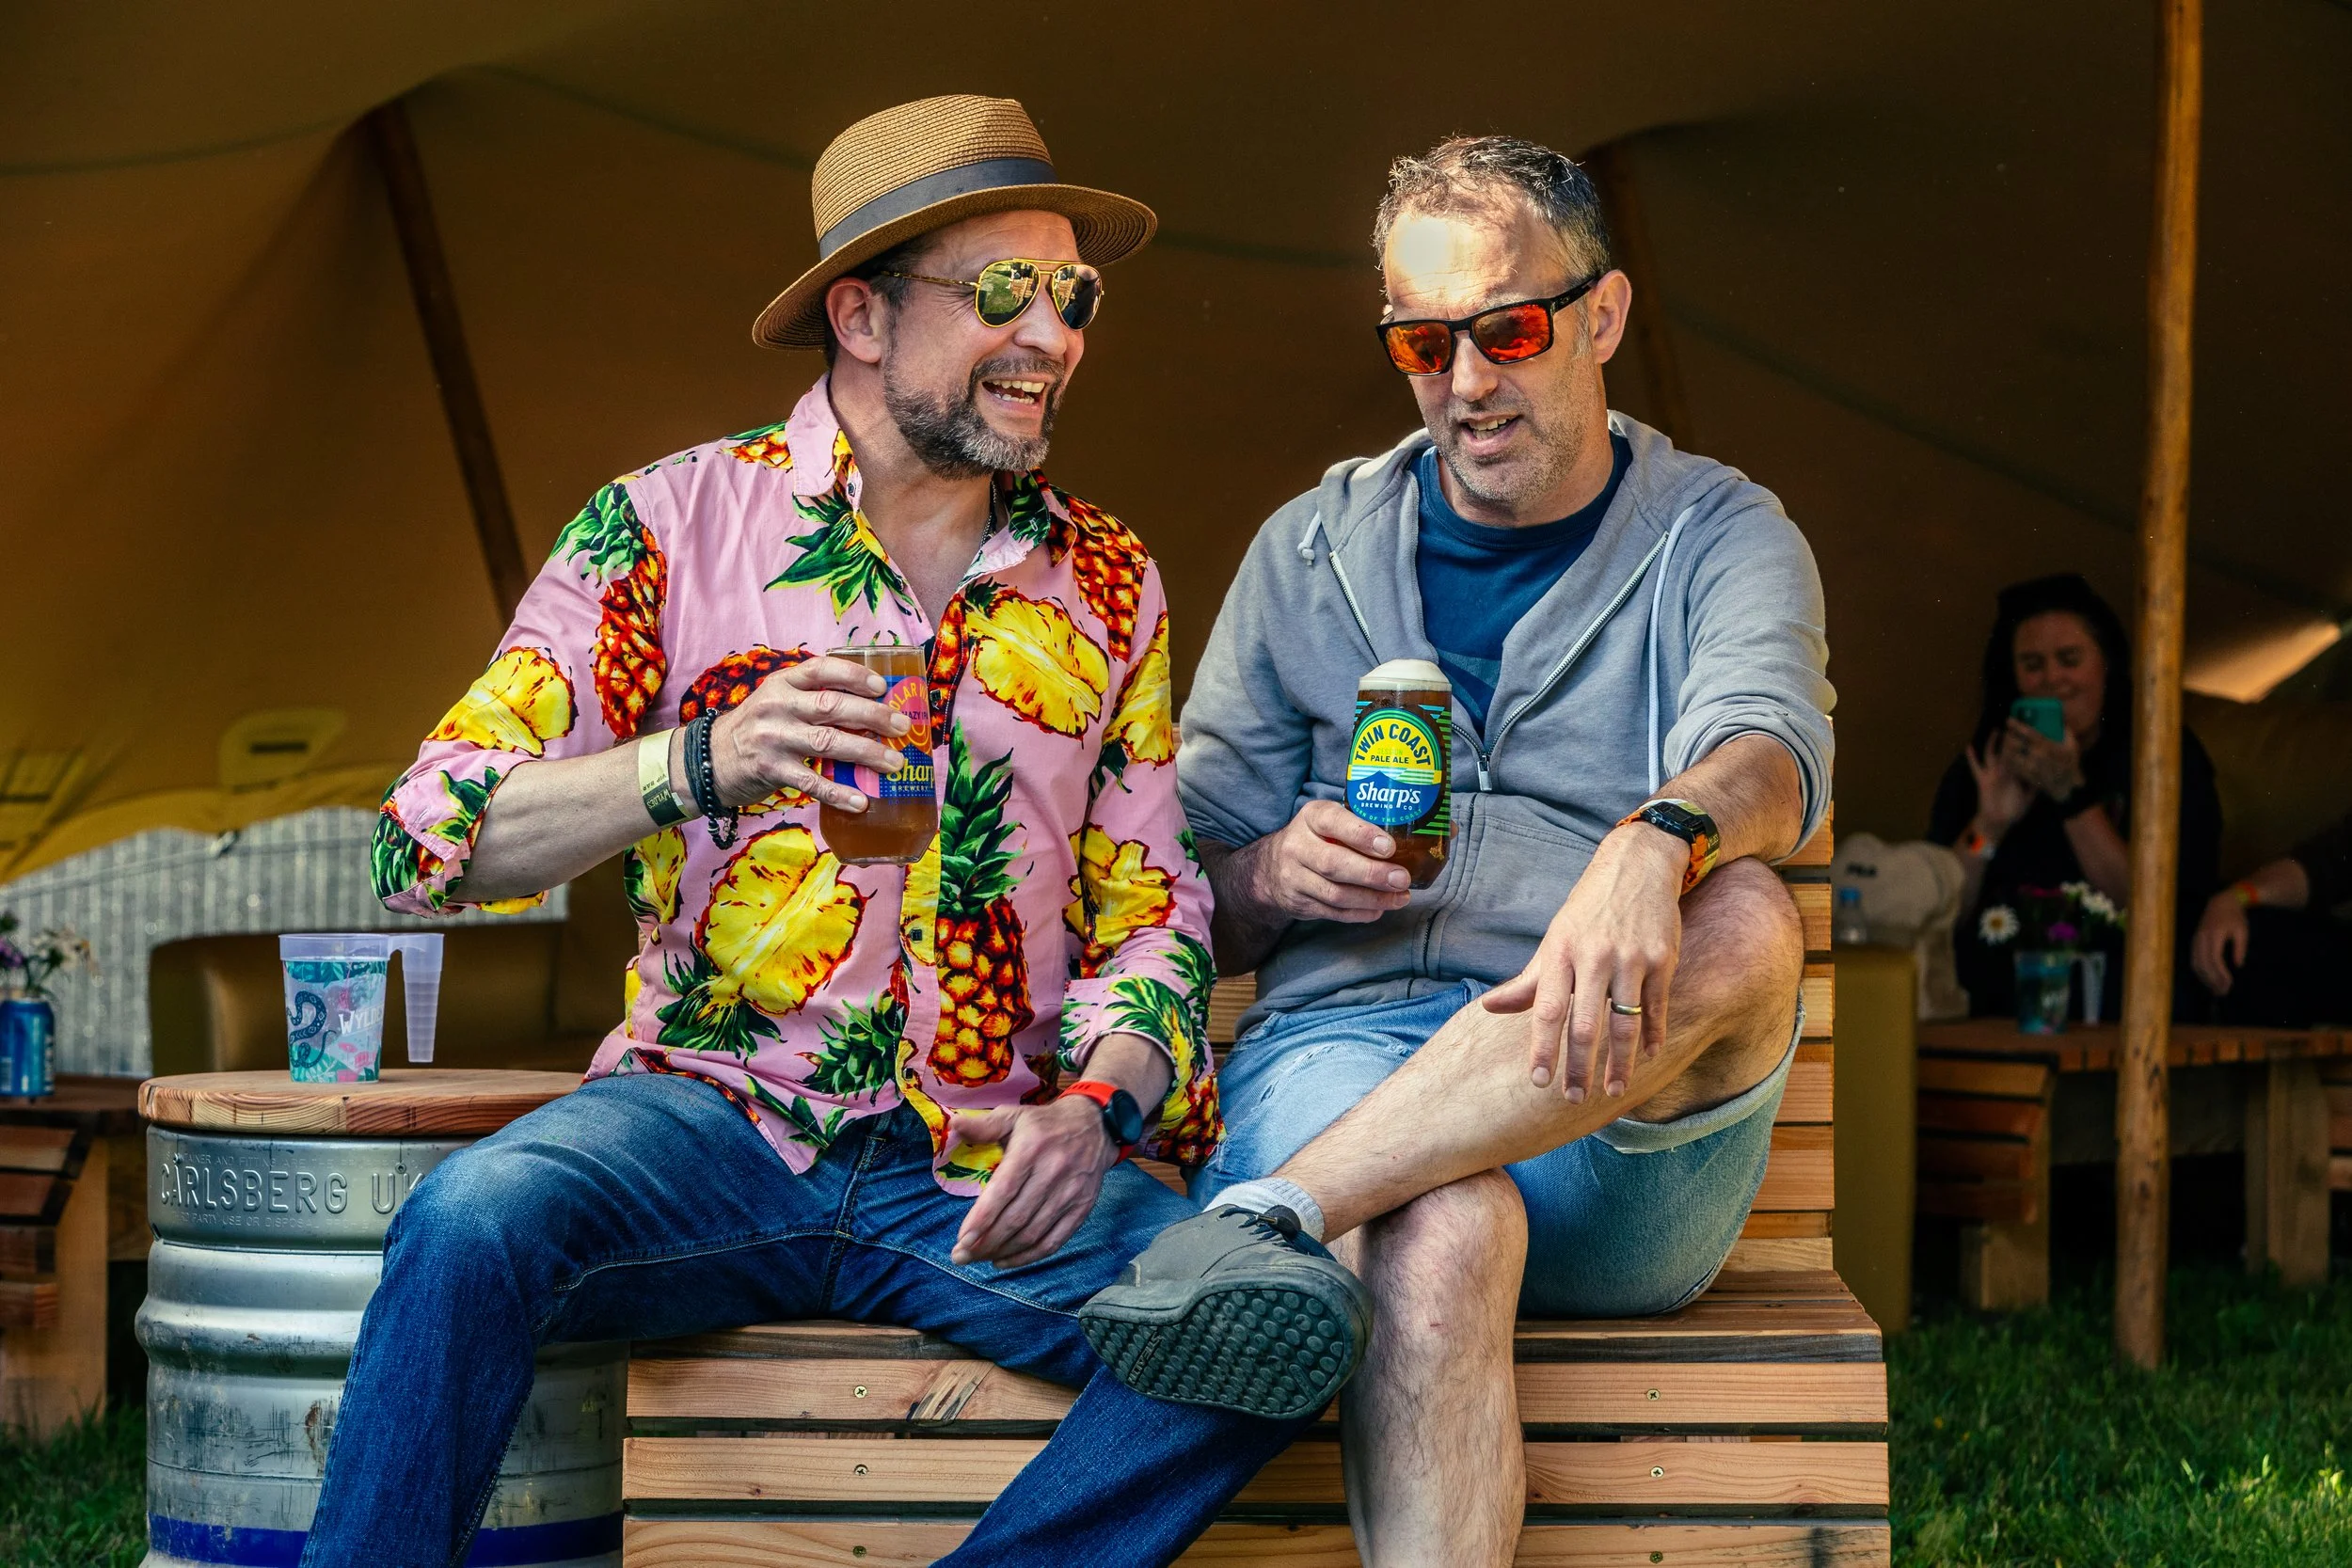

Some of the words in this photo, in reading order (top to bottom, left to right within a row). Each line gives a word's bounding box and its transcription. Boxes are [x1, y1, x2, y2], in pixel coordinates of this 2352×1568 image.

[888, 682, 918, 711] OLAR
[1355, 724, 1385, 761] TWIN
[1389, 723, 1431, 765] COAST
[643, 781, 655, 791] BAR
[656, 773, 666, 783] VIP
[646, 788, 671, 809] WYLDES
[1356, 782, 1422, 808] Sharp's
[1353, 804, 1367, 817] BORN
[1400, 808, 1422, 821] COAST
[161, 1164, 348, 1213] CARLSBERG
